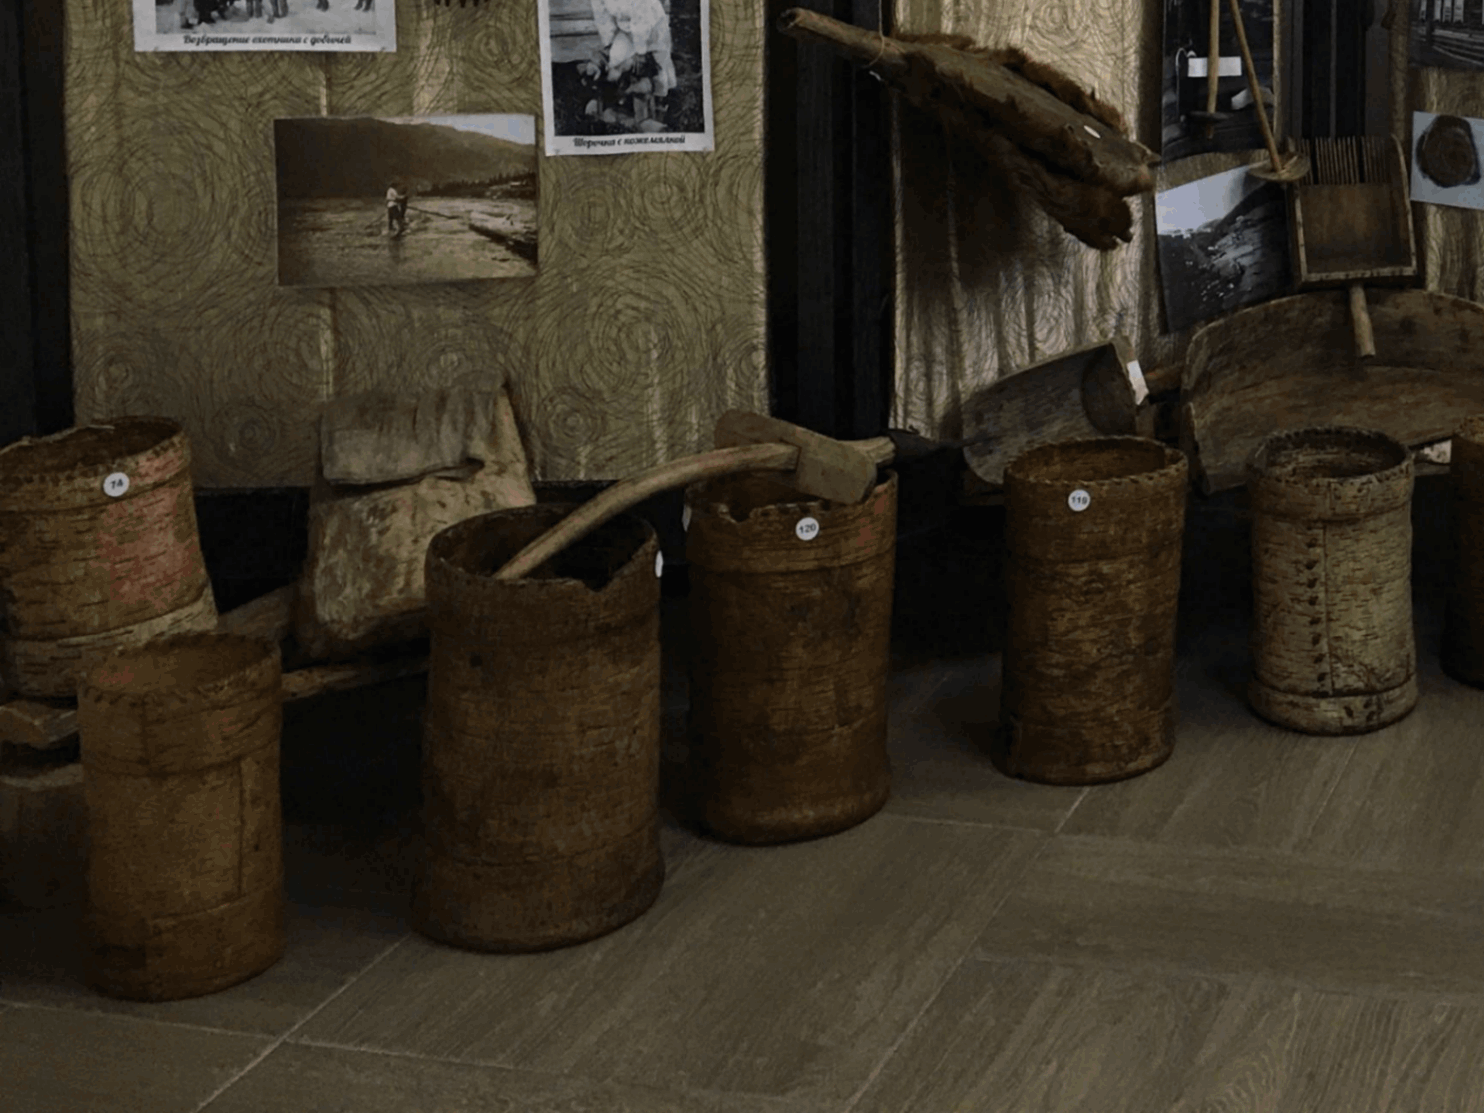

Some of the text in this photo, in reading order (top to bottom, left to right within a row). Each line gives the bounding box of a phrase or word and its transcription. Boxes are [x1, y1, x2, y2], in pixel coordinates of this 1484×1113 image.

[183, 35, 250, 46] Возвращение
[310, 34, 352, 46] добычей
[798, 523, 817, 534] 120
